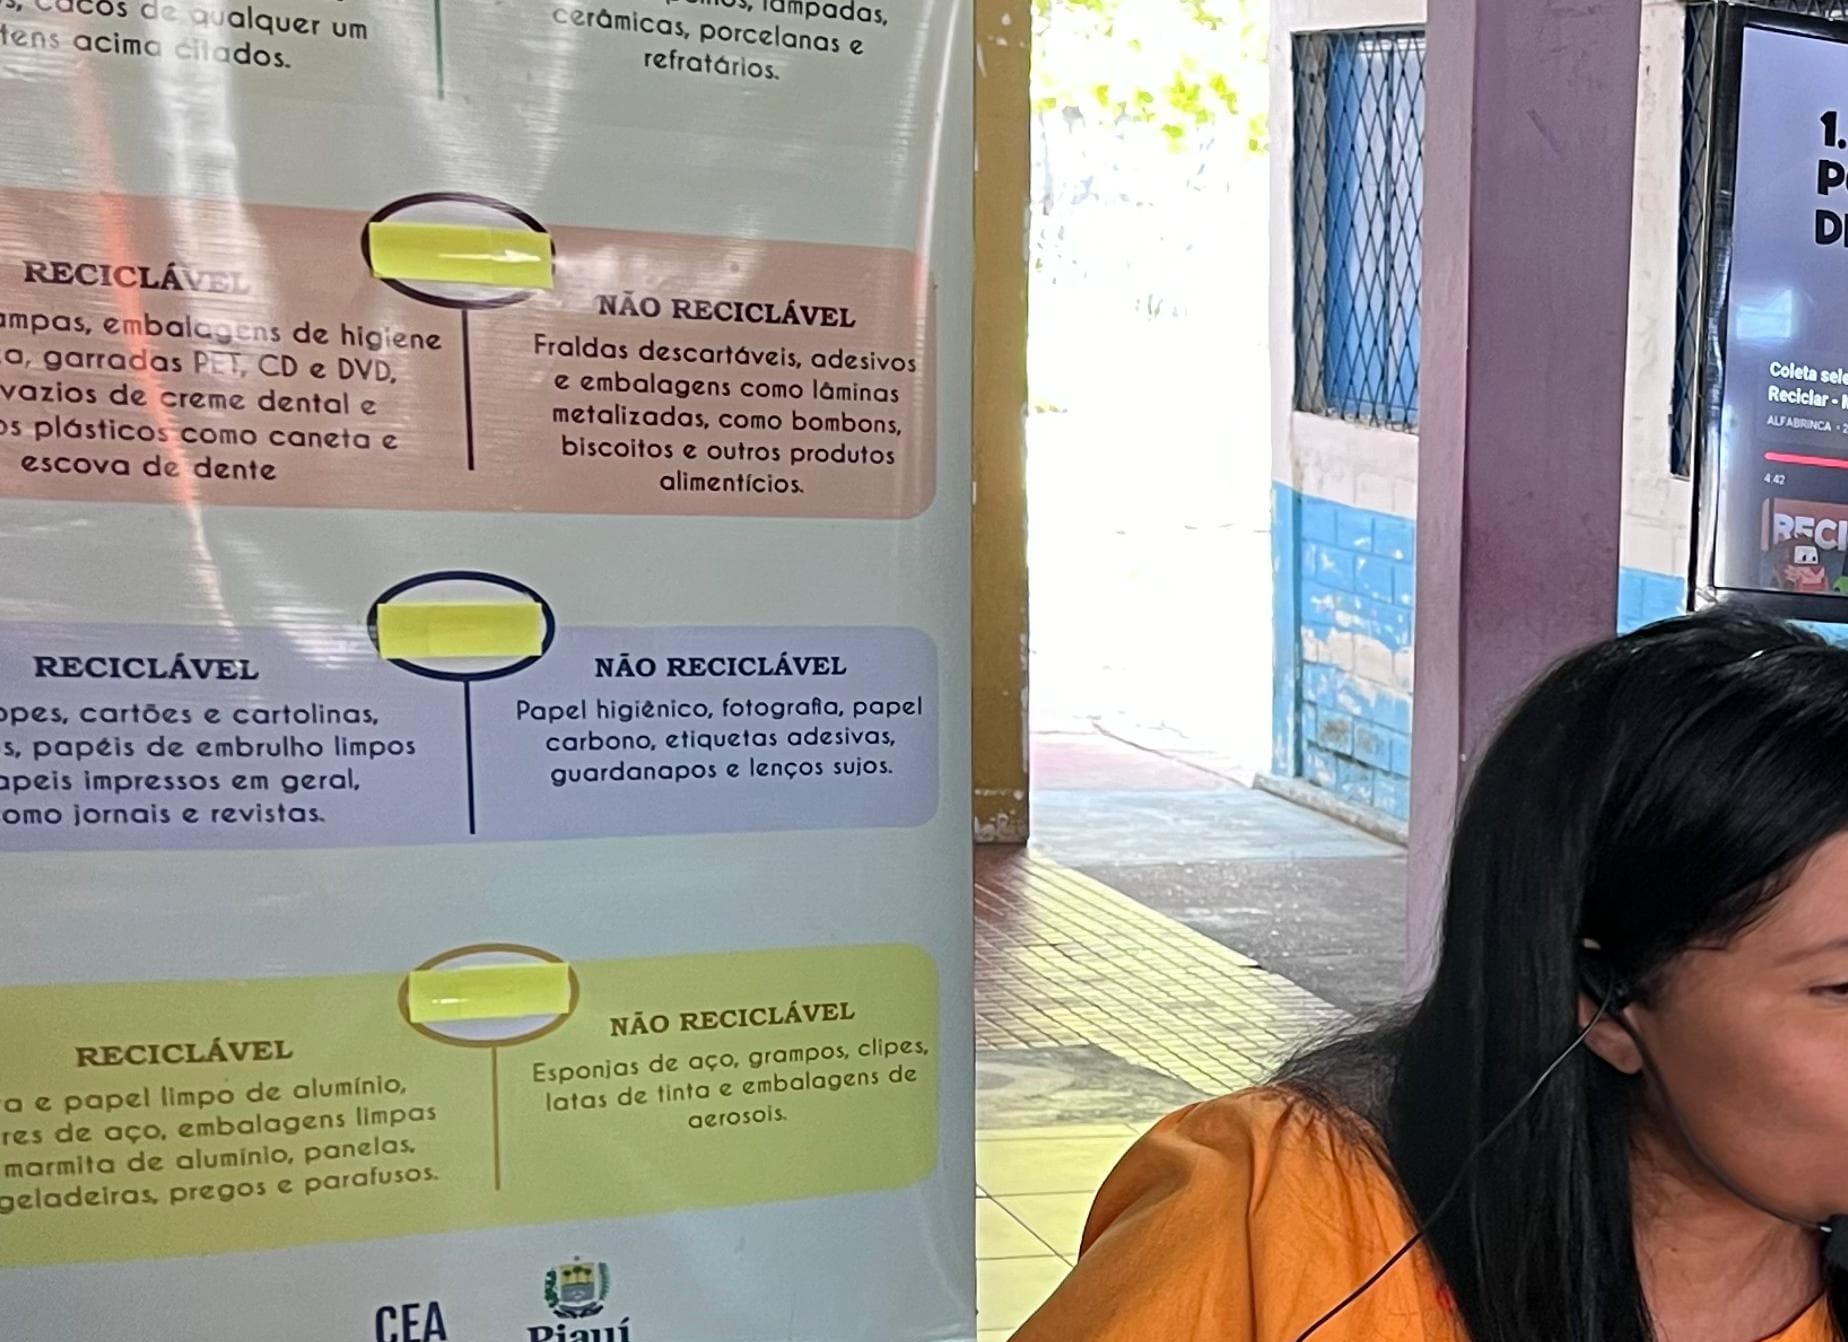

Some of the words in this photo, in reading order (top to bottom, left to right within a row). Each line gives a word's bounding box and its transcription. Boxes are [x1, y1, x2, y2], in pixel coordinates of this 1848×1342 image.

[192, 5, 320, 35] qualquer
[333, 22, 367, 39] um
[552, 8, 690, 40] cerâmicas,
[700, 24, 840, 52] porcelanas
[850, 39, 864, 55] e
[73, 33, 161, 56] acima
[644, 51, 780, 81] refratários.
[1819, 111, 1848, 151] 1.
[24, 260, 252, 296] RECICLÁVEL
[598, 291, 662, 318] NÃO
[672, 298, 856, 328] RECICLÁVEL
[103, 313, 281, 344] embalagens
[293, 321, 330, 344] de
[341, 322, 443, 353] higiene
[44, 348, 182, 374] garradas
[194, 350, 248, 380] PET,
[258, 354, 298, 378] CD
[310, 361, 327, 379] e
[534, 334, 629, 360] Fraldas
[639, 339, 802, 370] descartáveis,
[812, 350, 917, 373] adesivos
[1769, 361, 1817, 382] Coleta
[109, 382, 148, 407] de
[160, 389, 245, 411] creme
[258, 390, 350, 415] dental
[362, 399, 378, 416] e
[555, 374, 570, 391] e
[580, 372, 731, 398] embalagens
[741, 381, 804, 400] como
[812, 378, 900, 403] lâminas
[1768, 385, 1829, 407] Reciclar
[35, 414, 170, 444] plásticos
[181, 425, 258, 446] como
[269, 425, 370, 450] caneta
[382, 433, 399, 451] e
[552, 405, 709, 430] metalizadas,
[719, 412, 783, 430] como
[792, 411, 902, 436] bombons,
[1767, 415, 1832, 432] ALFABRINCA
[562, 436, 674, 460] biscoitos
[683, 444, 697, 460] e
[707, 442, 781, 463] outros
[790, 442, 896, 466] produtos
[21, 453, 130, 476] escova
[143, 454, 180, 478] de
[194, 458, 277, 481] dente
[660, 470, 804, 495] alimentícios.
[33, 653, 260, 680] RECICLÁVEL
[595, 652, 656, 678] NÃO
[667, 651, 847, 677] RECICLÁVEL
[80, 703, 192, 725] cartões
[204, 707, 221, 725] e
[234, 703, 379, 727] cartolinas,
[517, 699, 586, 723] Papel
[597, 699, 714, 723] higiênico,
[722, 696, 844, 722] fotografia,
[853, 696, 922, 719] papel
[33, 736, 135, 761] papéis
[147, 736, 184, 758] de
[197, 737, 323, 758] embrulho
[334, 736, 416, 760] limpos
[546, 730, 656, 752] carbono,
[666, 729, 778, 750] etiquetas
[787, 727, 896, 748] adesivas,
[85, 770, 220, 794] impressos
[232, 773, 269, 791] em
[282, 768, 361, 794] geral,
[551, 761, 716, 787] guardanapos
[727, 762, 740, 778] e
[749, 757, 824, 780] lenços
[833, 756, 893, 778] sujos.
[73, 803, 171, 826] jornais
[182, 806, 199, 824] e
[211, 803, 325, 824] revistas.
[610, 1011, 670, 1037] NÃO
[680, 1001, 855, 1032] RECICLÁVEL
[75, 1037, 294, 1068] RECICLÁVEL
[532, 1061, 639, 1086] Esponjas
[649, 1053, 678, 1075] de
[688, 1051, 740, 1072] aço,
[748, 1042, 850, 1069] grampos,
[857, 1037, 929, 1059] clipes,
[35, 1096, 52, 1112] e
[64, 1086, 150, 1115] papel
[161, 1085, 234, 1110] limpo
[246, 1082, 282, 1102] de
[293, 1074, 407, 1099] alumínio,
[546, 1091, 607, 1112] latas
[617, 1086, 648, 1107] de
[657, 1081, 710, 1103] tinta
[719, 1081, 733, 1098] e
[742, 1070, 880, 1096] embalagens
[888, 1064, 918, 1084] de
[2, 1130, 43, 1146] res
[55, 1121, 92, 1144] de
[104, 1124, 167, 1145] aço,
[178, 1111, 345, 1140] embalagens
[356, 1103, 437, 1127] limpas
[688, 1105, 788, 1130] aerosois.
[4, 1155, 115, 1178] marmita
[127, 1150, 164, 1174] de
[175, 1145, 294, 1171] alumínio,
[169, 1179, 267, 1206] pregos
[277, 1178, 294, 1195] e
[304, 1164, 440, 1196] parafusos.
